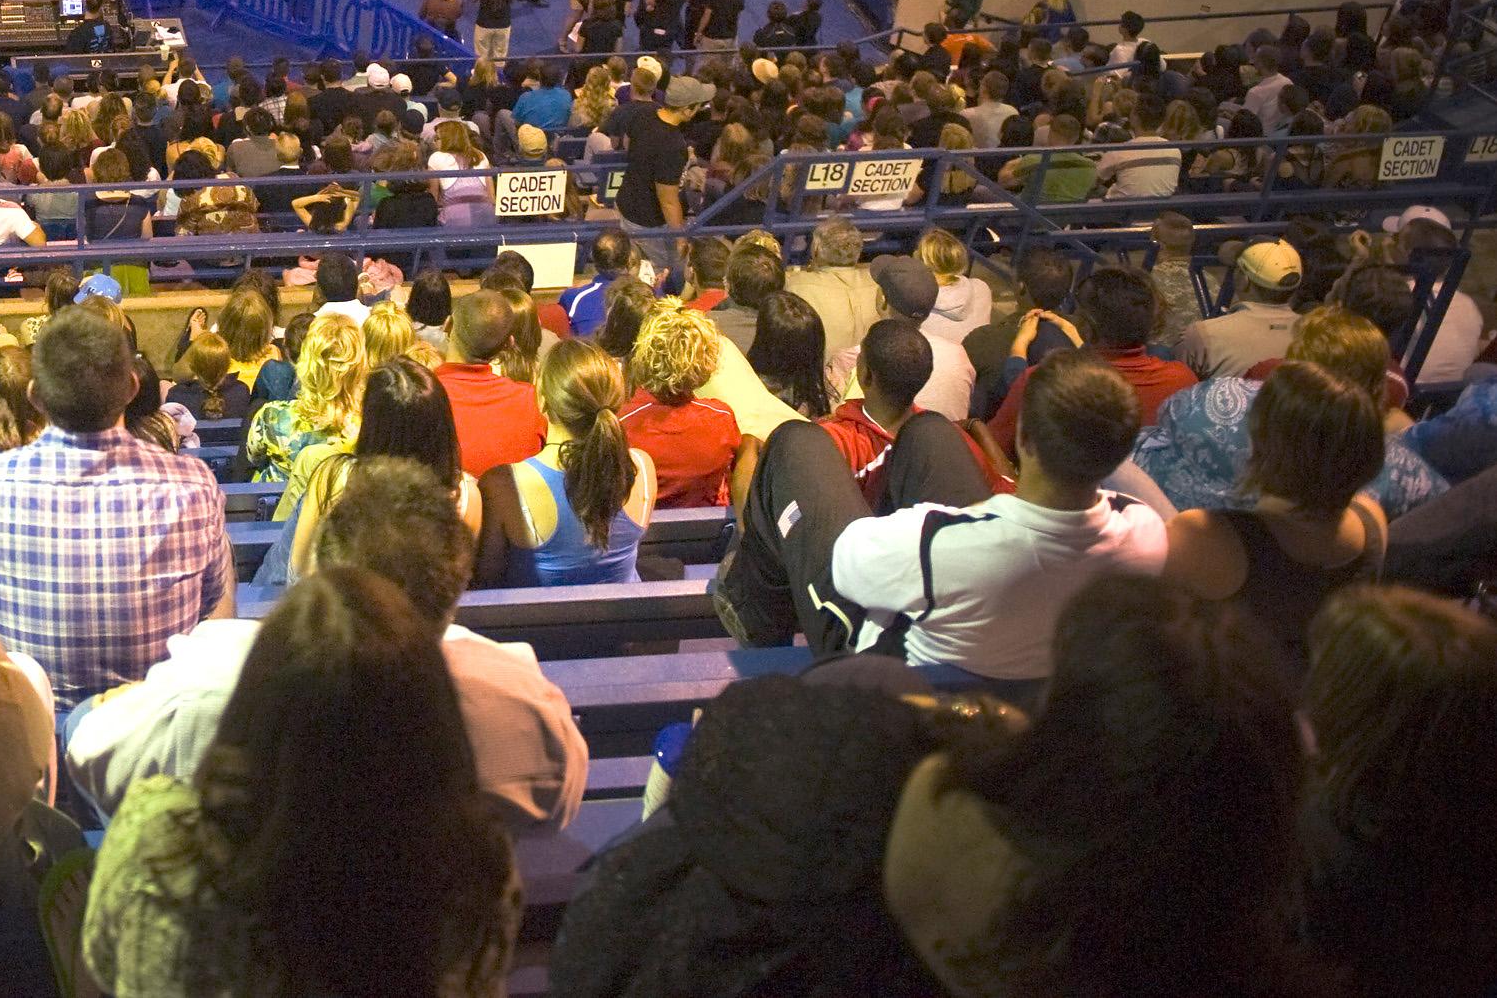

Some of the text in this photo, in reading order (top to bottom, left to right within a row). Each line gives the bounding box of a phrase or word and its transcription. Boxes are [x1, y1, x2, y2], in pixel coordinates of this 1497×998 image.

[1393, 139, 1436, 157] CADET
[808, 163, 845, 182] L18
[864, 162, 912, 177] CADET
[1383, 159, 1437, 177] SECTION
[508, 175, 556, 193] CADET
[851, 177, 912, 192] SECTION
[499, 194, 561, 212] SECTION
